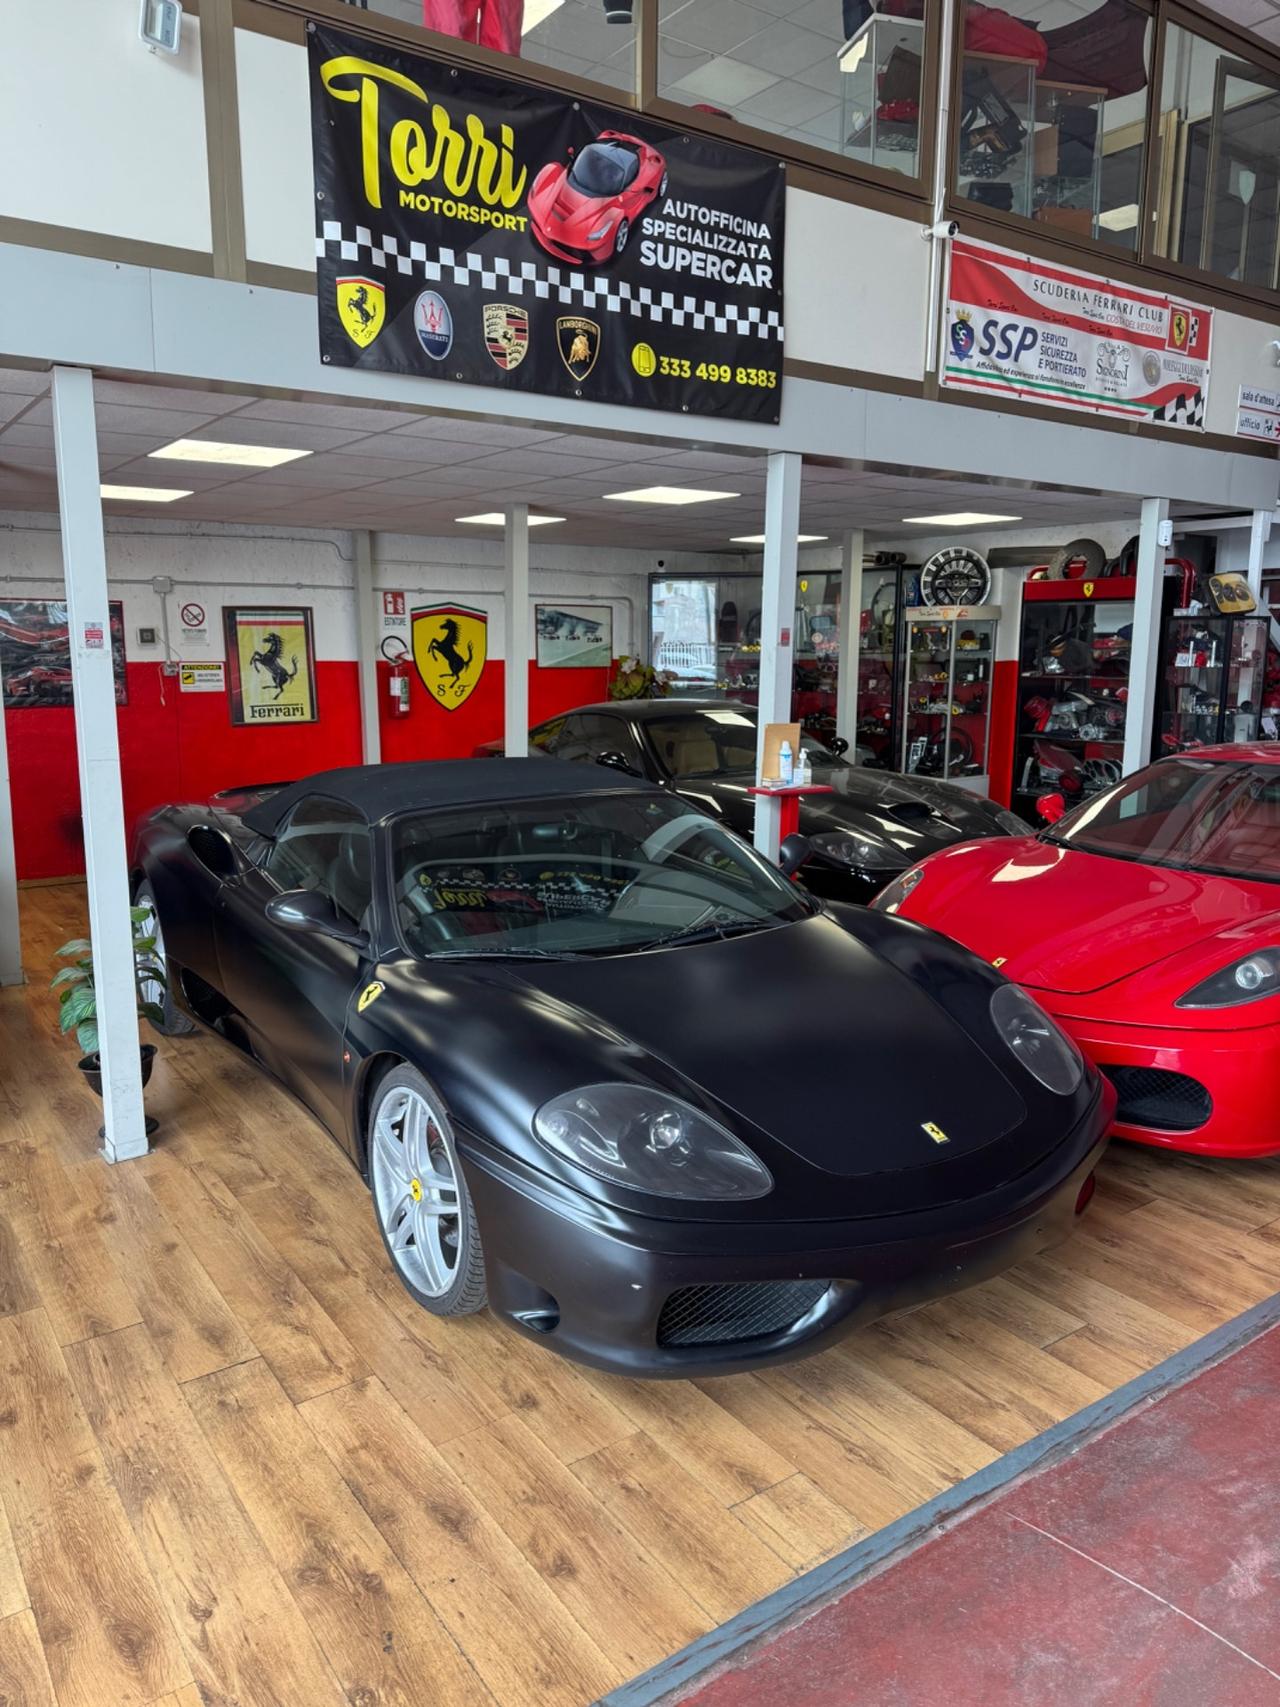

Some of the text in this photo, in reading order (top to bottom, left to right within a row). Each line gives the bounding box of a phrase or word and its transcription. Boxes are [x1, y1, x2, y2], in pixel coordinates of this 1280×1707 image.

[320, 56, 527, 209] Torri
[399, 190, 528, 232] MOTORSPORT
[662, 198, 772, 240] AUTOFFICINA
[641, 217, 772, 261] SPECIALIZZATA
[639, 240, 773, 289] SUPERCAR
[485, 305, 527, 318] PORSCHE
[1033, 279, 1089, 304] SCUDERIA
[1093, 294, 1134, 317] FERRARI
[1138, 306, 1164, 323] CLUB
[978, 318, 1039, 364] SSP
[1041, 331, 1068, 347] SERVIZI
[1040, 345, 1079, 362] SICUREZZA
[659, 355, 777, 389] 333 499 8383
[1038, 360, 1044, 369] E
[1045, 361, 1087, 378] PORTIERATO
[1242, 391, 1254, 402] sala
[1240, 416, 1260, 431] ufficio
[437, 684, 472, 697] S F
[249, 703, 305, 719] Ferrari
